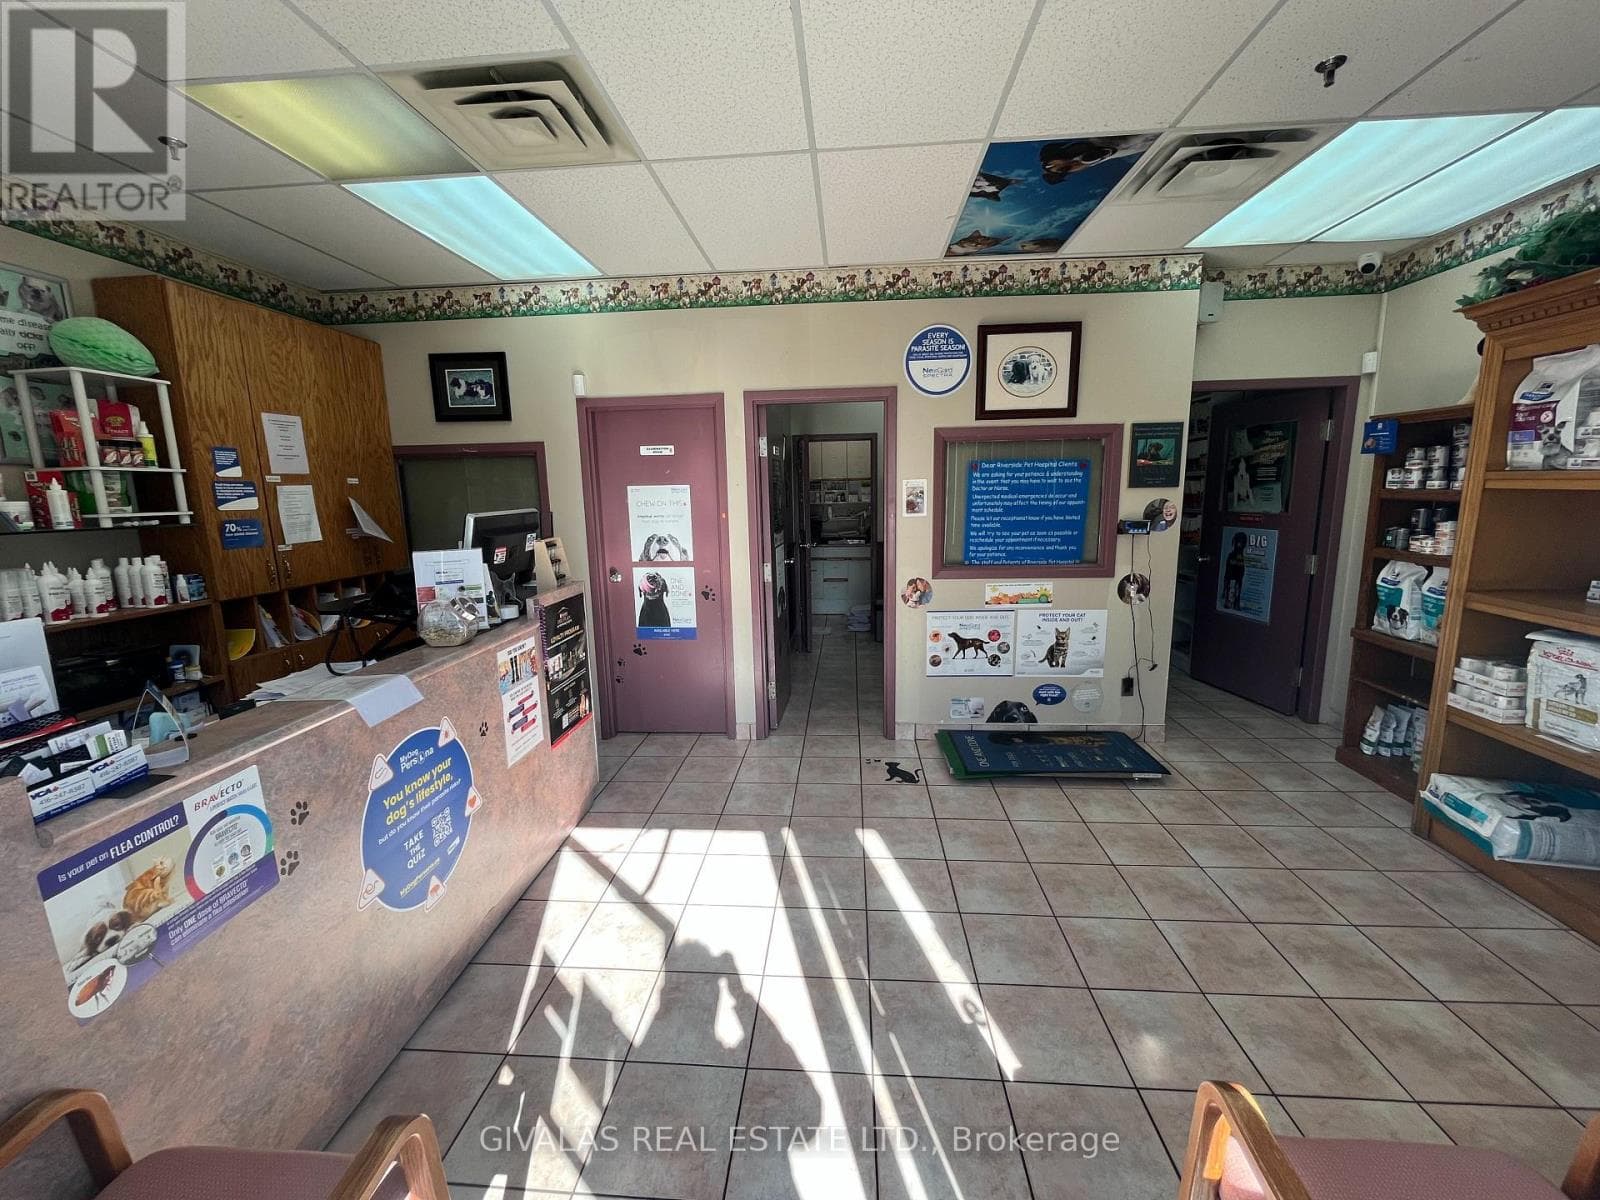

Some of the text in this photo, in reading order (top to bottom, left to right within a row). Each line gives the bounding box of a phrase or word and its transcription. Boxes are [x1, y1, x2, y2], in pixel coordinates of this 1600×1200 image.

[194, 780, 244, 812] BRAVECTO
[383, 757, 452, 809] You know your
[386, 773, 453, 825] dog's lifestyle,
[58, 815, 180, 882] Is your pet on FLEA CONTROL?
[404, 829, 425, 850] TAKE
[407, 848, 426, 869] QUIZ
[410, 843, 421, 856] THE
[168, 926, 183, 939] Only
[183, 915, 197, 928] ONE
[197, 905, 212, 919] dose
[212, 899, 219, 908] of
[170, 934, 182, 946] can
[212, 907, 222, 918] flea
[223, 887, 249, 909] infestation
